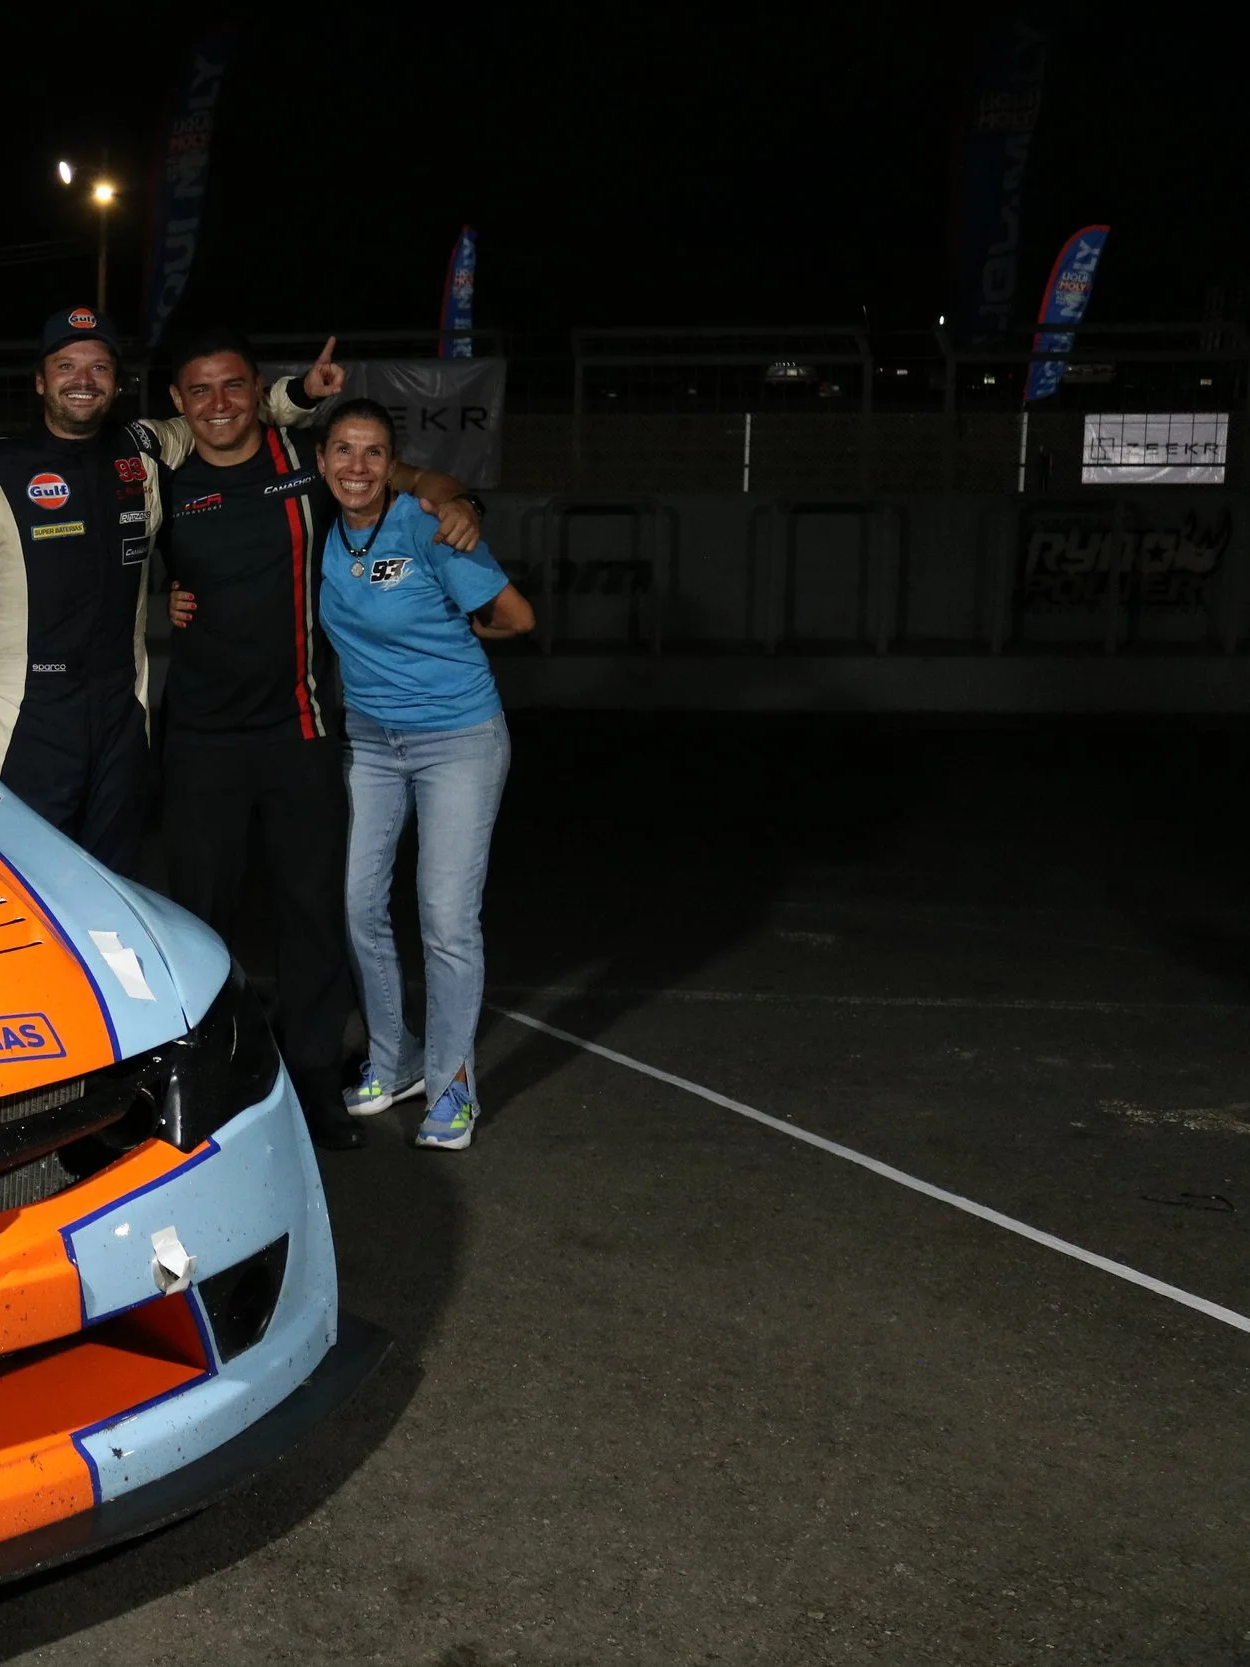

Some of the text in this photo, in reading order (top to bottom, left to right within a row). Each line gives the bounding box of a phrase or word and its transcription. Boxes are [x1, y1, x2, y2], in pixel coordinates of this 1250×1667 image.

[114, 456, 147, 482] 93
[29, 484, 69, 498] Gulf
[263, 476, 312, 495] CAMACHO
[34, 527, 55, 537] SUPER
[370, 558, 406, 583] 93
[32, 663, 66, 672] sparco
